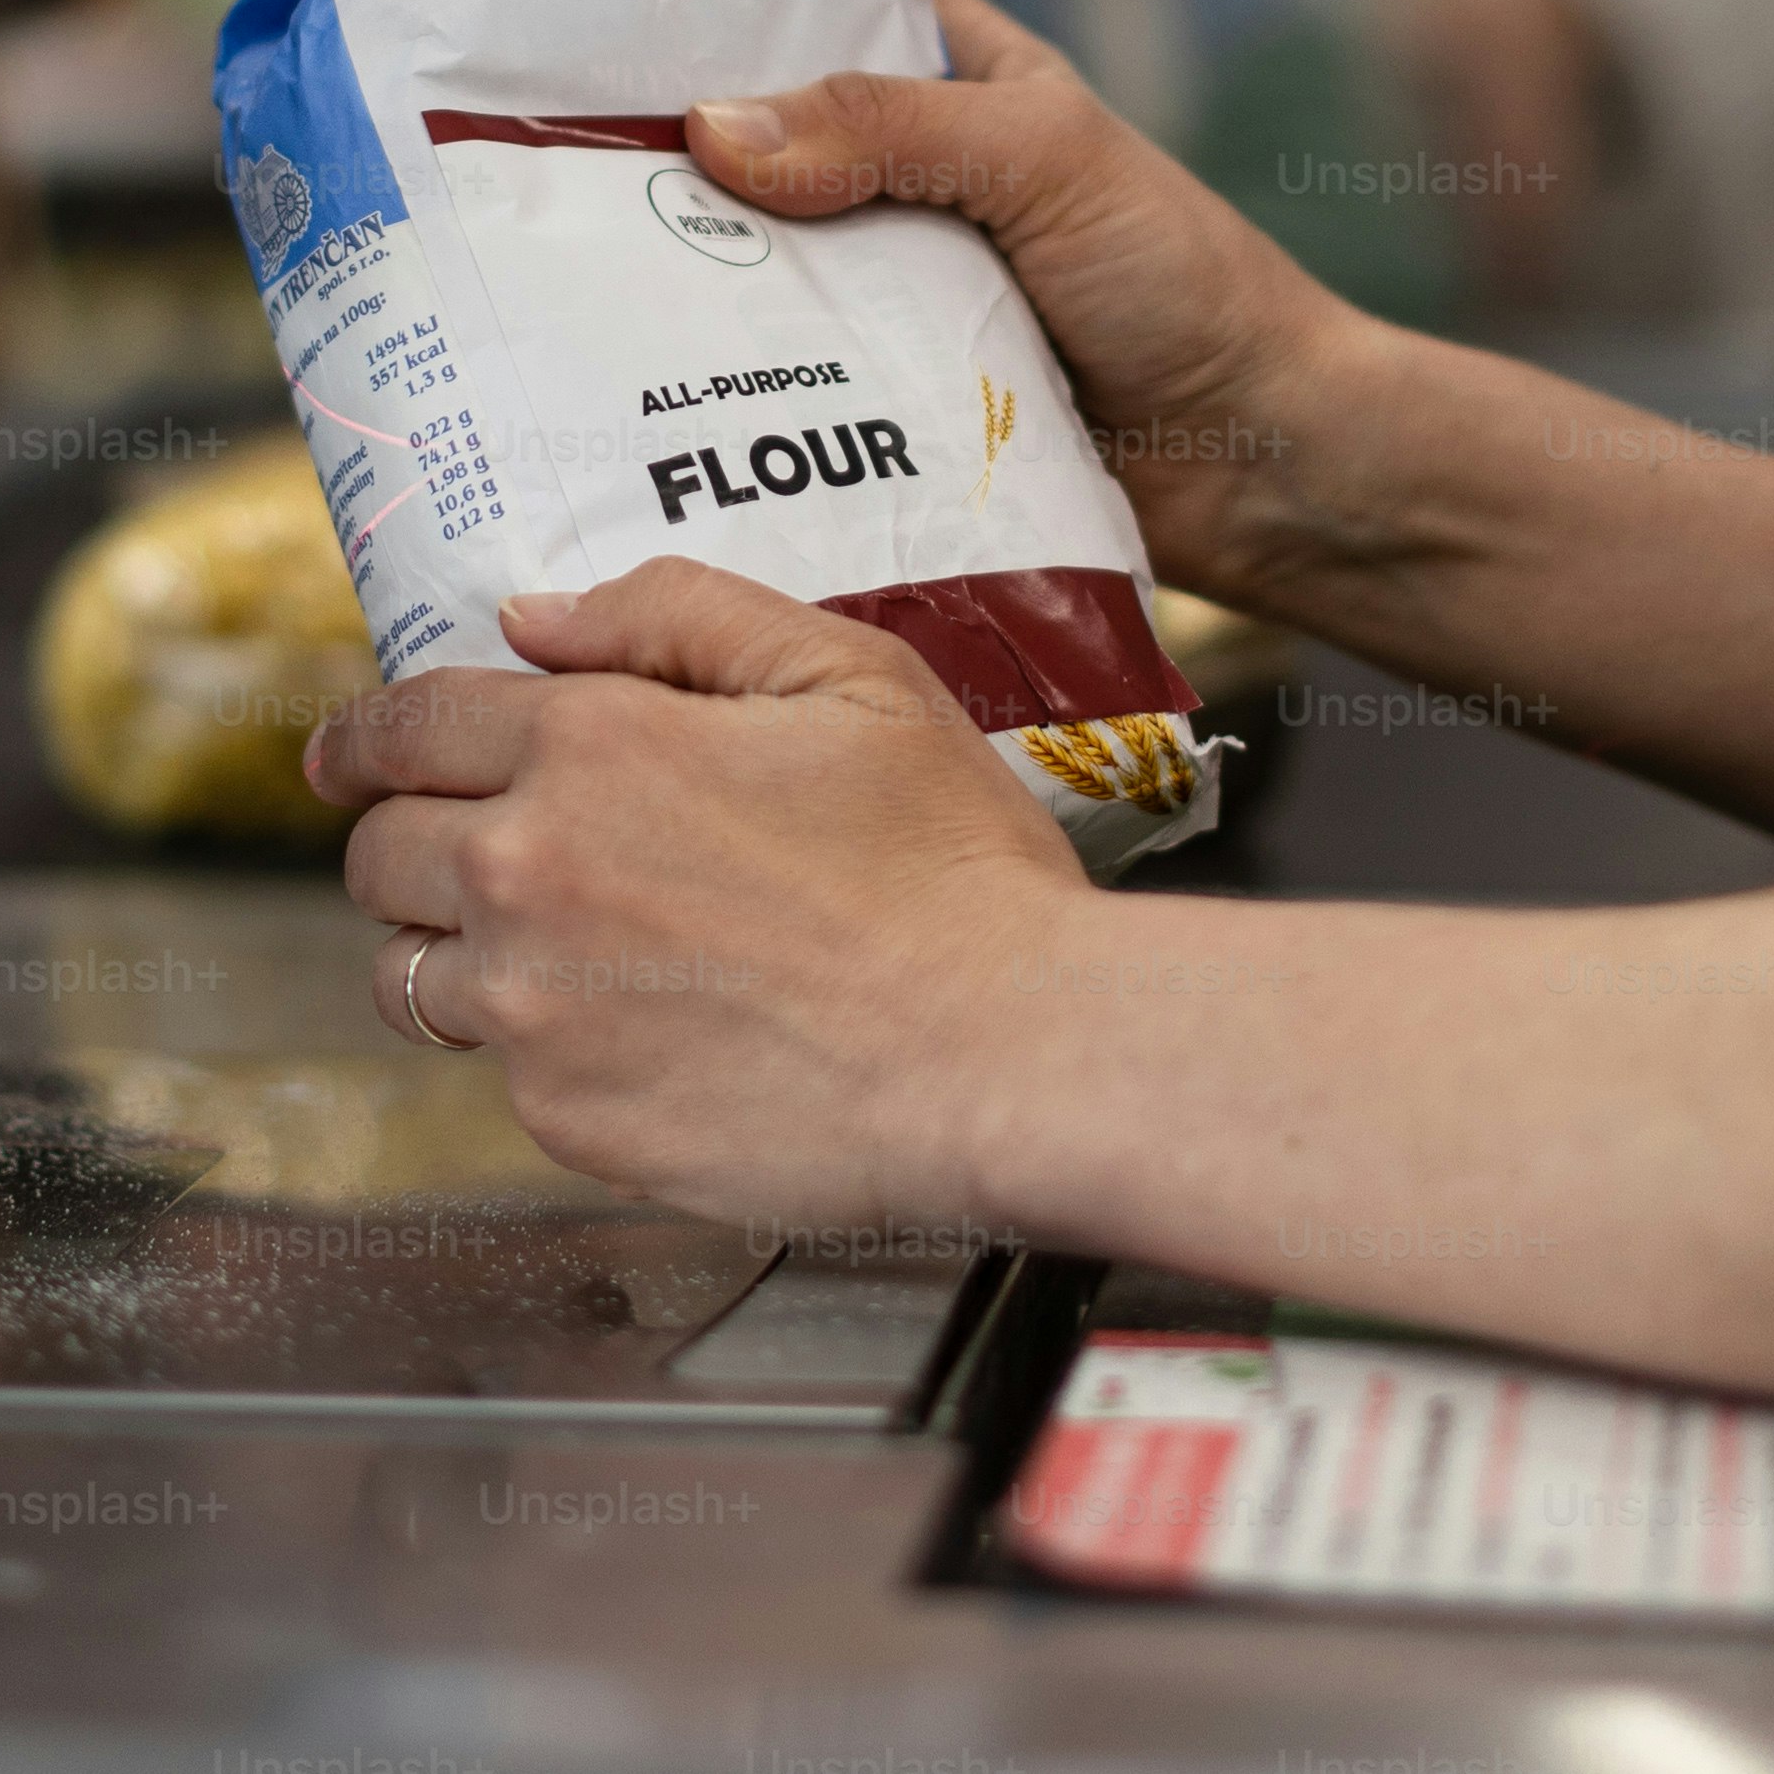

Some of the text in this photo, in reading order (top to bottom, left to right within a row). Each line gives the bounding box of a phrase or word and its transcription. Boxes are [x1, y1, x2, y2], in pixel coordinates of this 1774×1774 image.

[280, 212, 387, 313] TRENČAN
[318, 270, 348, 301] spol.
[323, 324, 340, 345] na
[339, 291, 387, 330] 100g:
[365, 314, 439, 367] 1494 kJ
[369, 336, 449, 392] 357 kcal
[405, 362, 458, 398] 1,3 g
[642, 361, 850, 416] ALL-PURPOSE
[409, 408, 474, 449] 0,22 g
[418, 431, 482, 473] 74,1 g
[647, 418, 921, 525] FLOUR
[426, 453, 490, 496] 1,98 g
[434, 477, 498, 519] 10,6 g
[442, 499, 505, 541] 0,12 g
[390, 601, 434, 645] glutén.
[406, 616, 455, 657] suchu.
